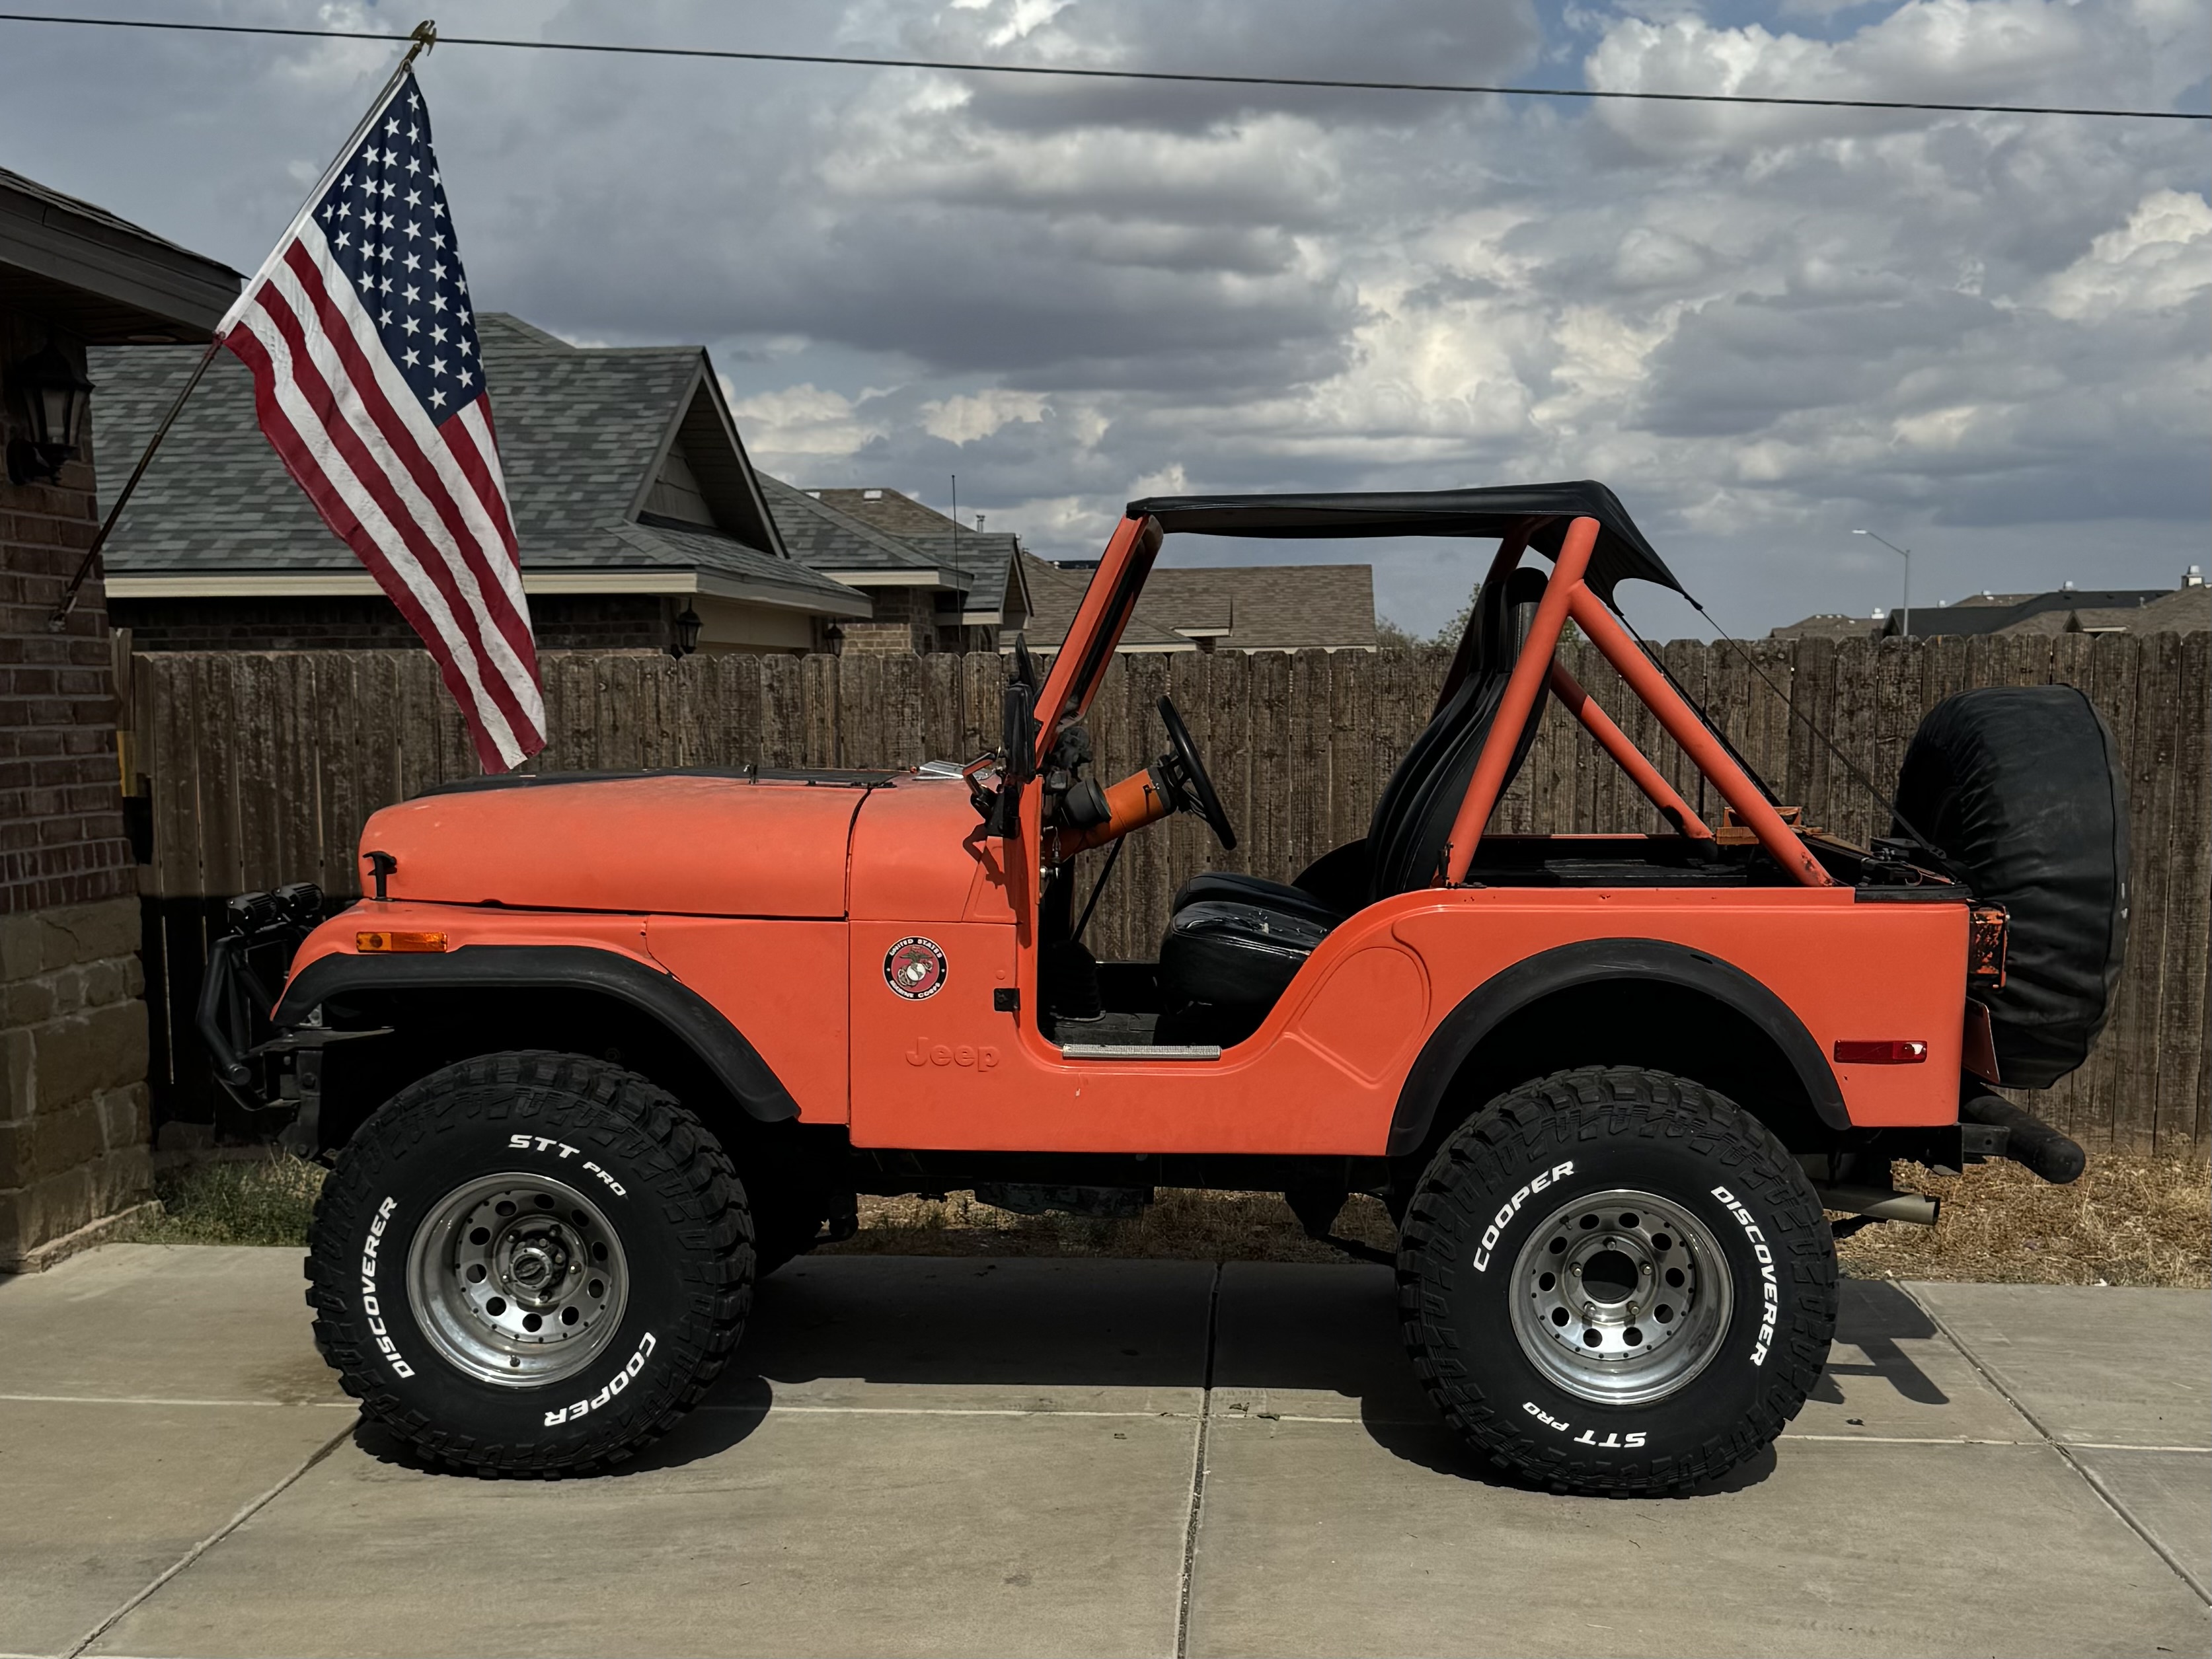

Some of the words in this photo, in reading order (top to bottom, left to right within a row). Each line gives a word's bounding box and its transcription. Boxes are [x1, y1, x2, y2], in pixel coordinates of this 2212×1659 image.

[889, 938, 914, 956] UNITED
[917, 939, 942, 958] STATES
[905, 1036, 1001, 1072] Jeep
[508, 1134, 580, 1158] STT
[582, 1161, 628, 1197] PRO
[1472, 1160, 1575, 1272] COOPER
[361, 1197, 416, 1379] DISCOVERER
[1710, 1186, 1779, 1366] DISCOVERER
[543, 1331, 657, 1427] COOPER
[1521, 1401, 1570, 1432] PRO
[1573, 1428, 1648, 1449] STT
